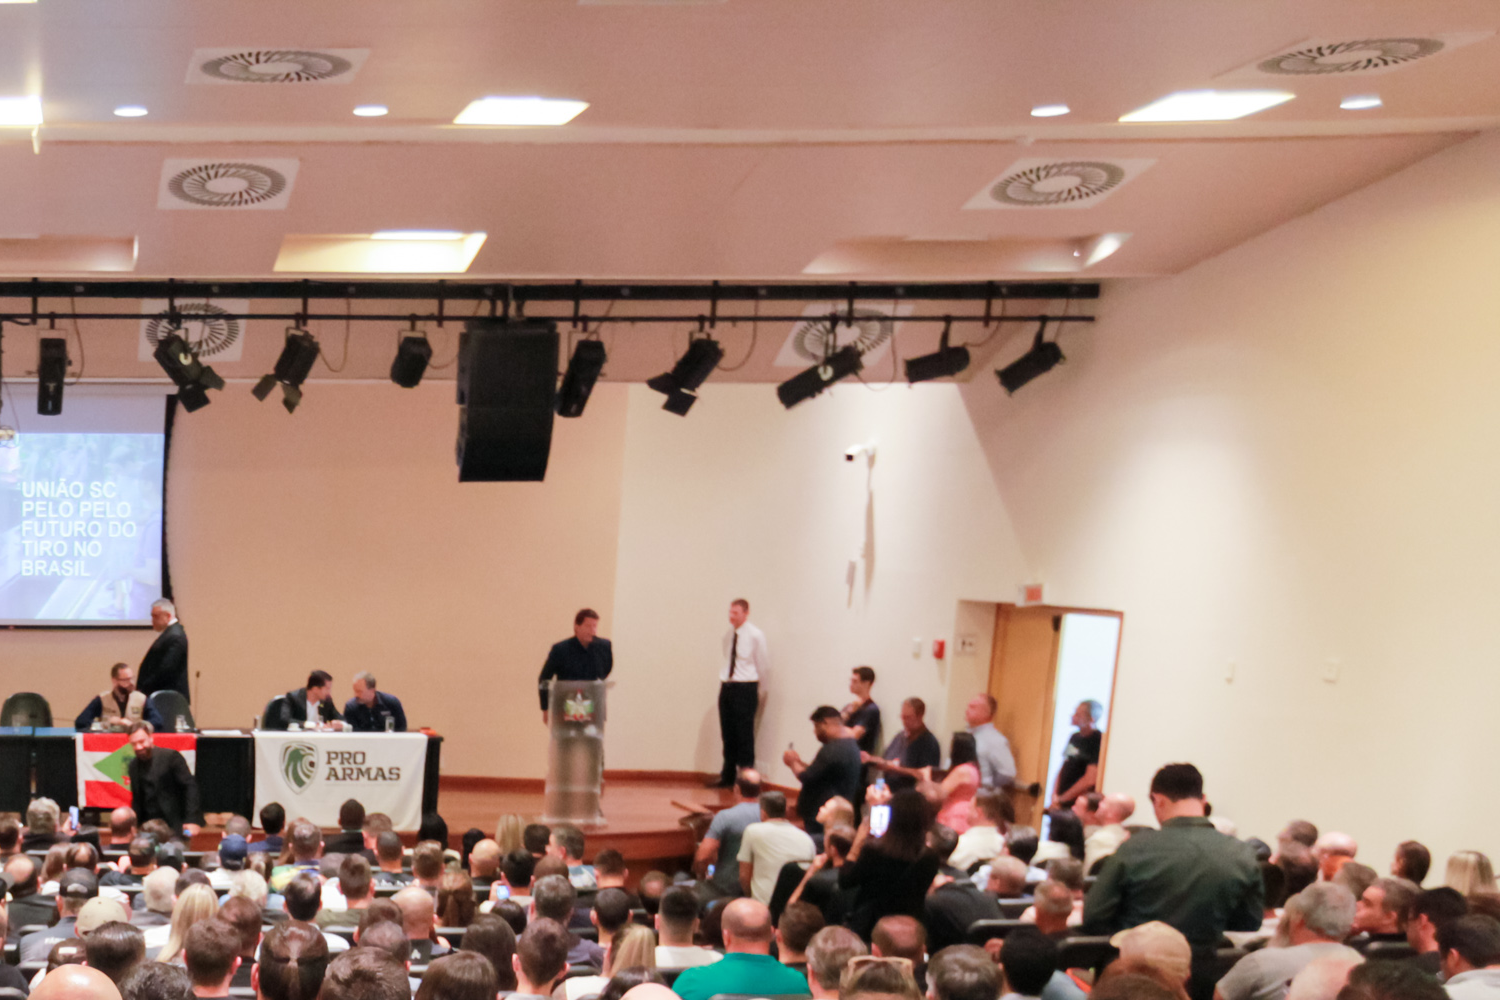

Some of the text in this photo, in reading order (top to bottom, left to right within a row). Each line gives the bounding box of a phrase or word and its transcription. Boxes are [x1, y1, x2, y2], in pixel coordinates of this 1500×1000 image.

[22, 478, 116, 498] UNIÃO SC
[22, 501, 131, 518] PELO PELO
[22, 521, 136, 537] FUTURO DO
[21, 540, 102, 557] TIRO NO
[21, 560, 90, 576] BRASIL
[326, 751, 366, 766] PRO
[325, 767, 401, 781] ARMAS
